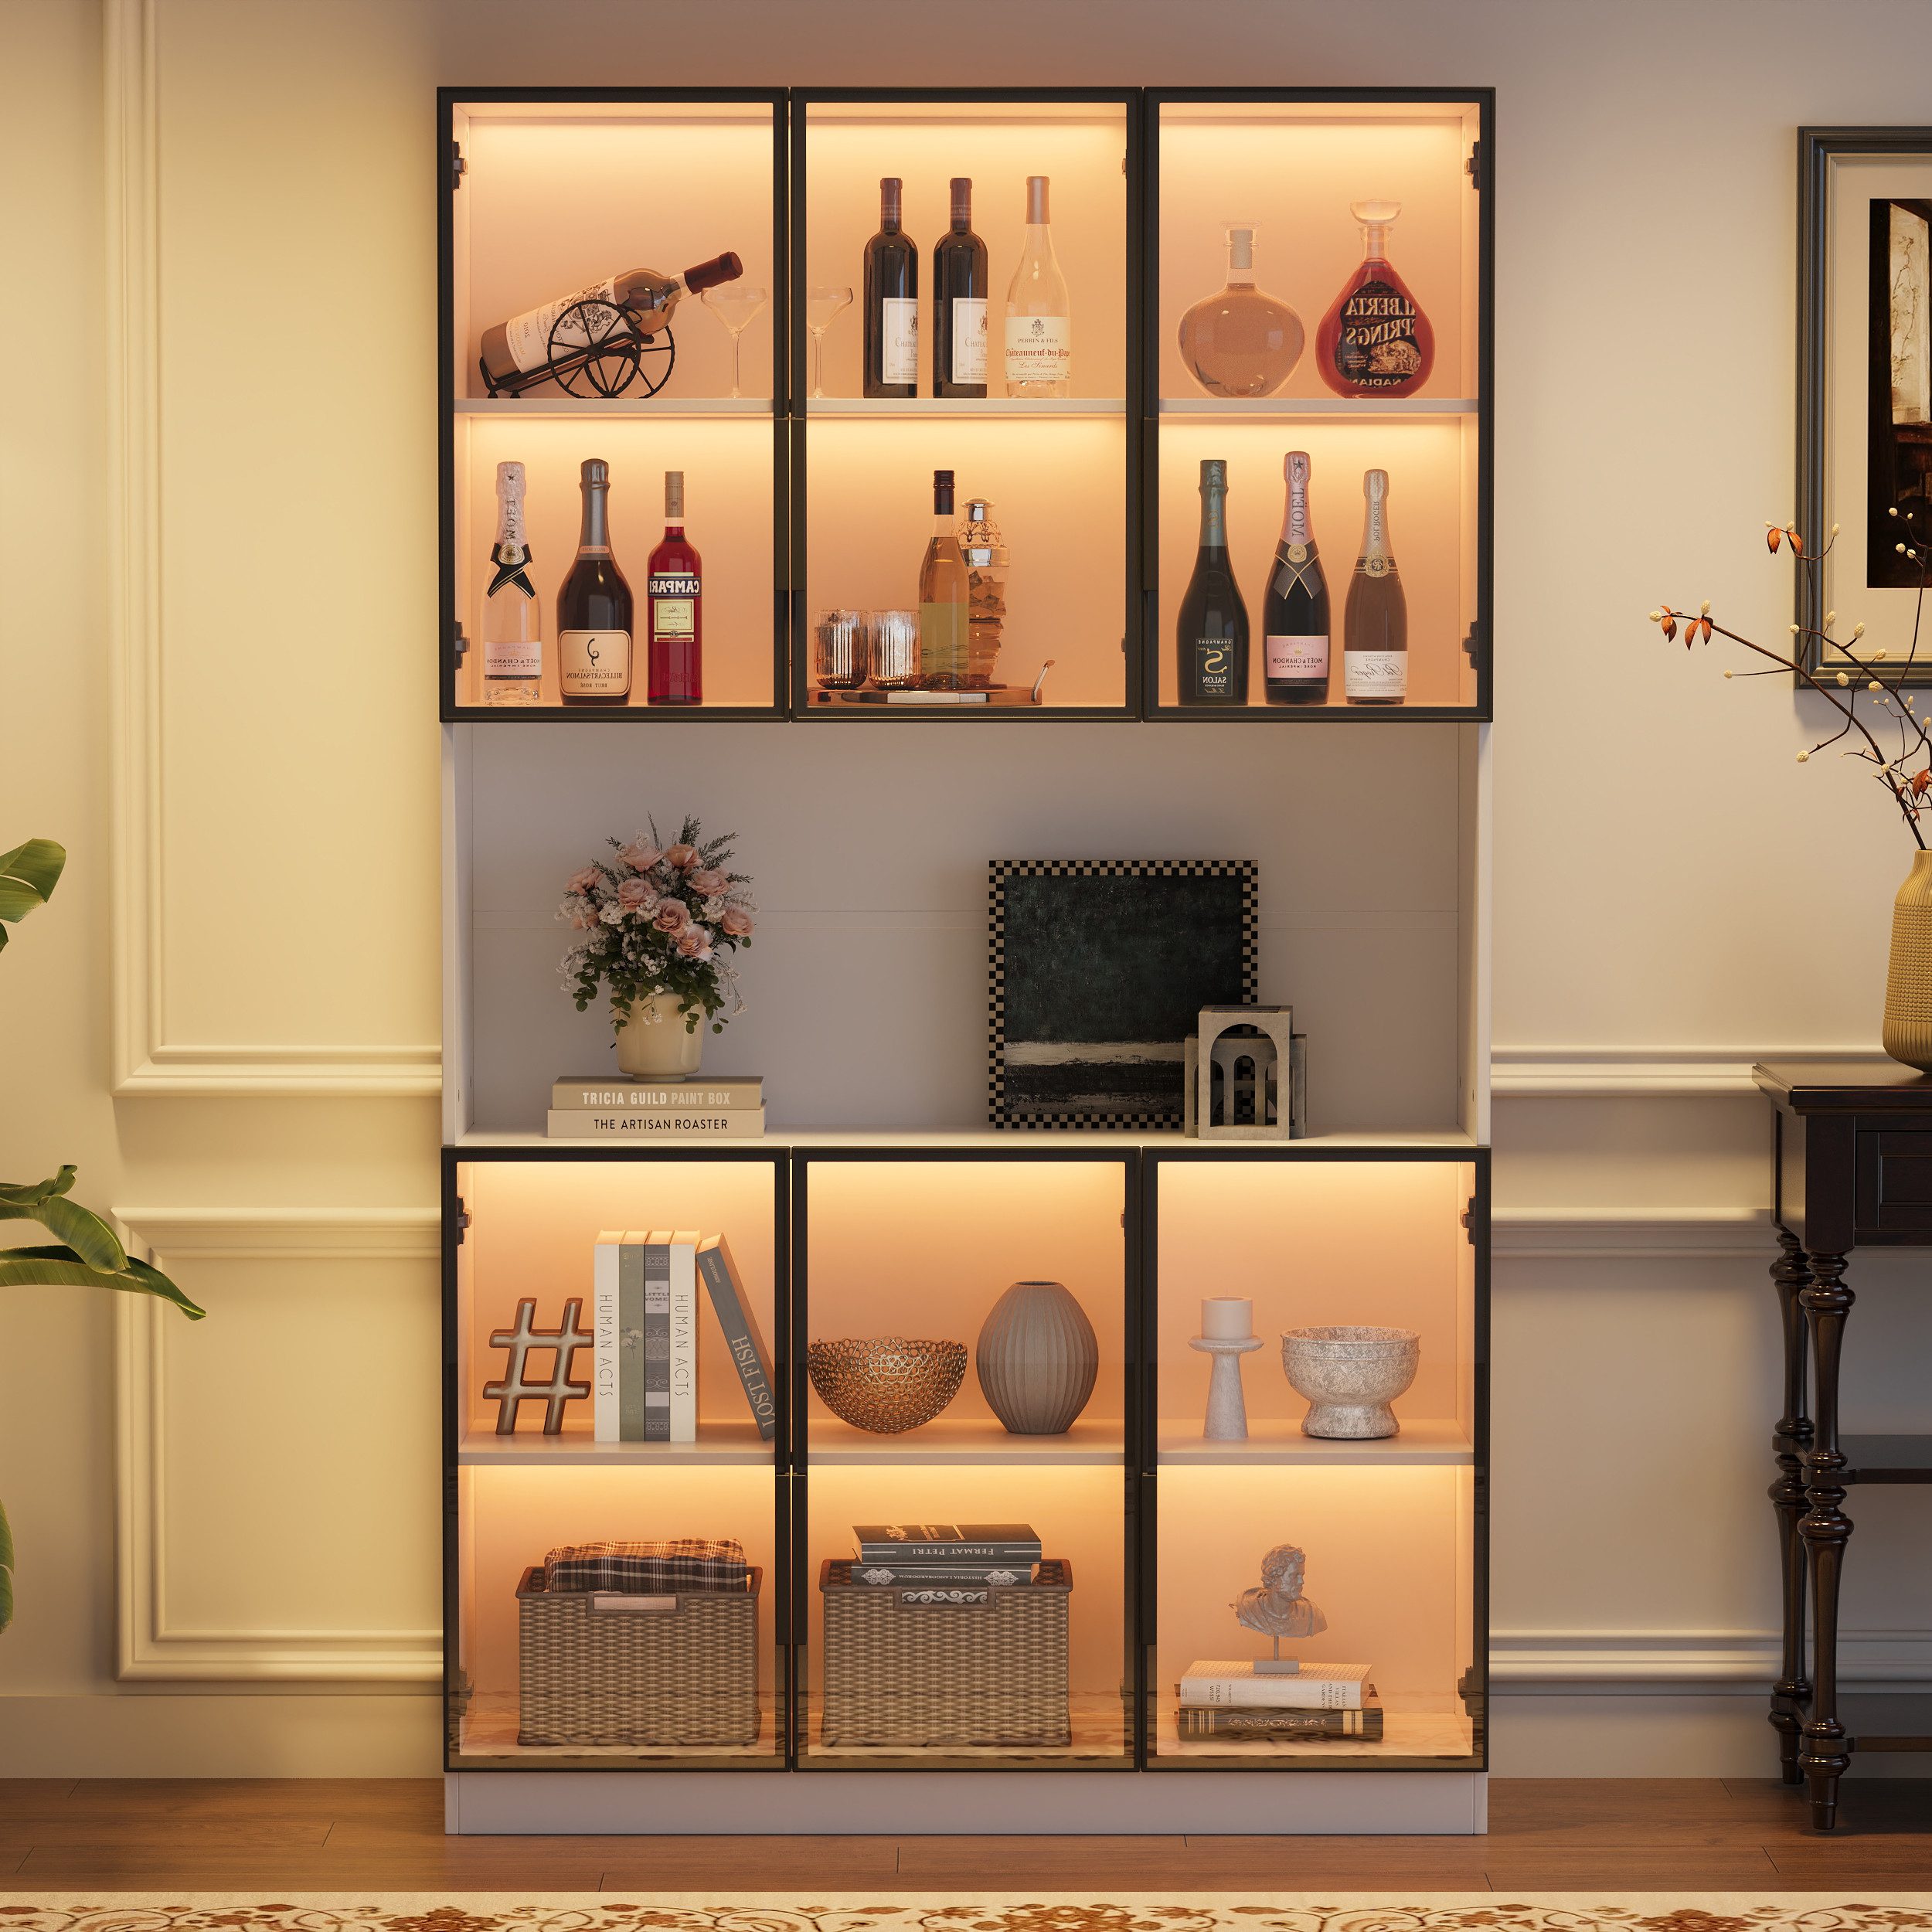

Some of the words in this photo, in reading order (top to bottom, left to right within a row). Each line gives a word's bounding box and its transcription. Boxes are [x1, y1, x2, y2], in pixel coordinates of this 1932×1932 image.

[583, 1092, 624, 1105] TRICIA
[630, 1092, 667, 1105] GUILD
[671, 1092, 704, 1105] PAINT
[708, 1092, 730, 1105] BOX
[594, 1119, 615, 1130] THE
[621, 1119, 672, 1130] ARTISAN
[675, 1119, 728, 1130] ROASTER
[599, 1294, 613, 1348] HUMAN
[675, 1294, 689, 1348] HUMAN
[599, 1357, 613, 1396] ACTS
[675, 1357, 689, 1396] ACTS
[731, 1335, 760, 1379] FISH
[748, 1382, 775, 1428] LOST
[912, 1546, 945, 1556] PETRI
[950, 1546, 995, 1556] FERMAT
